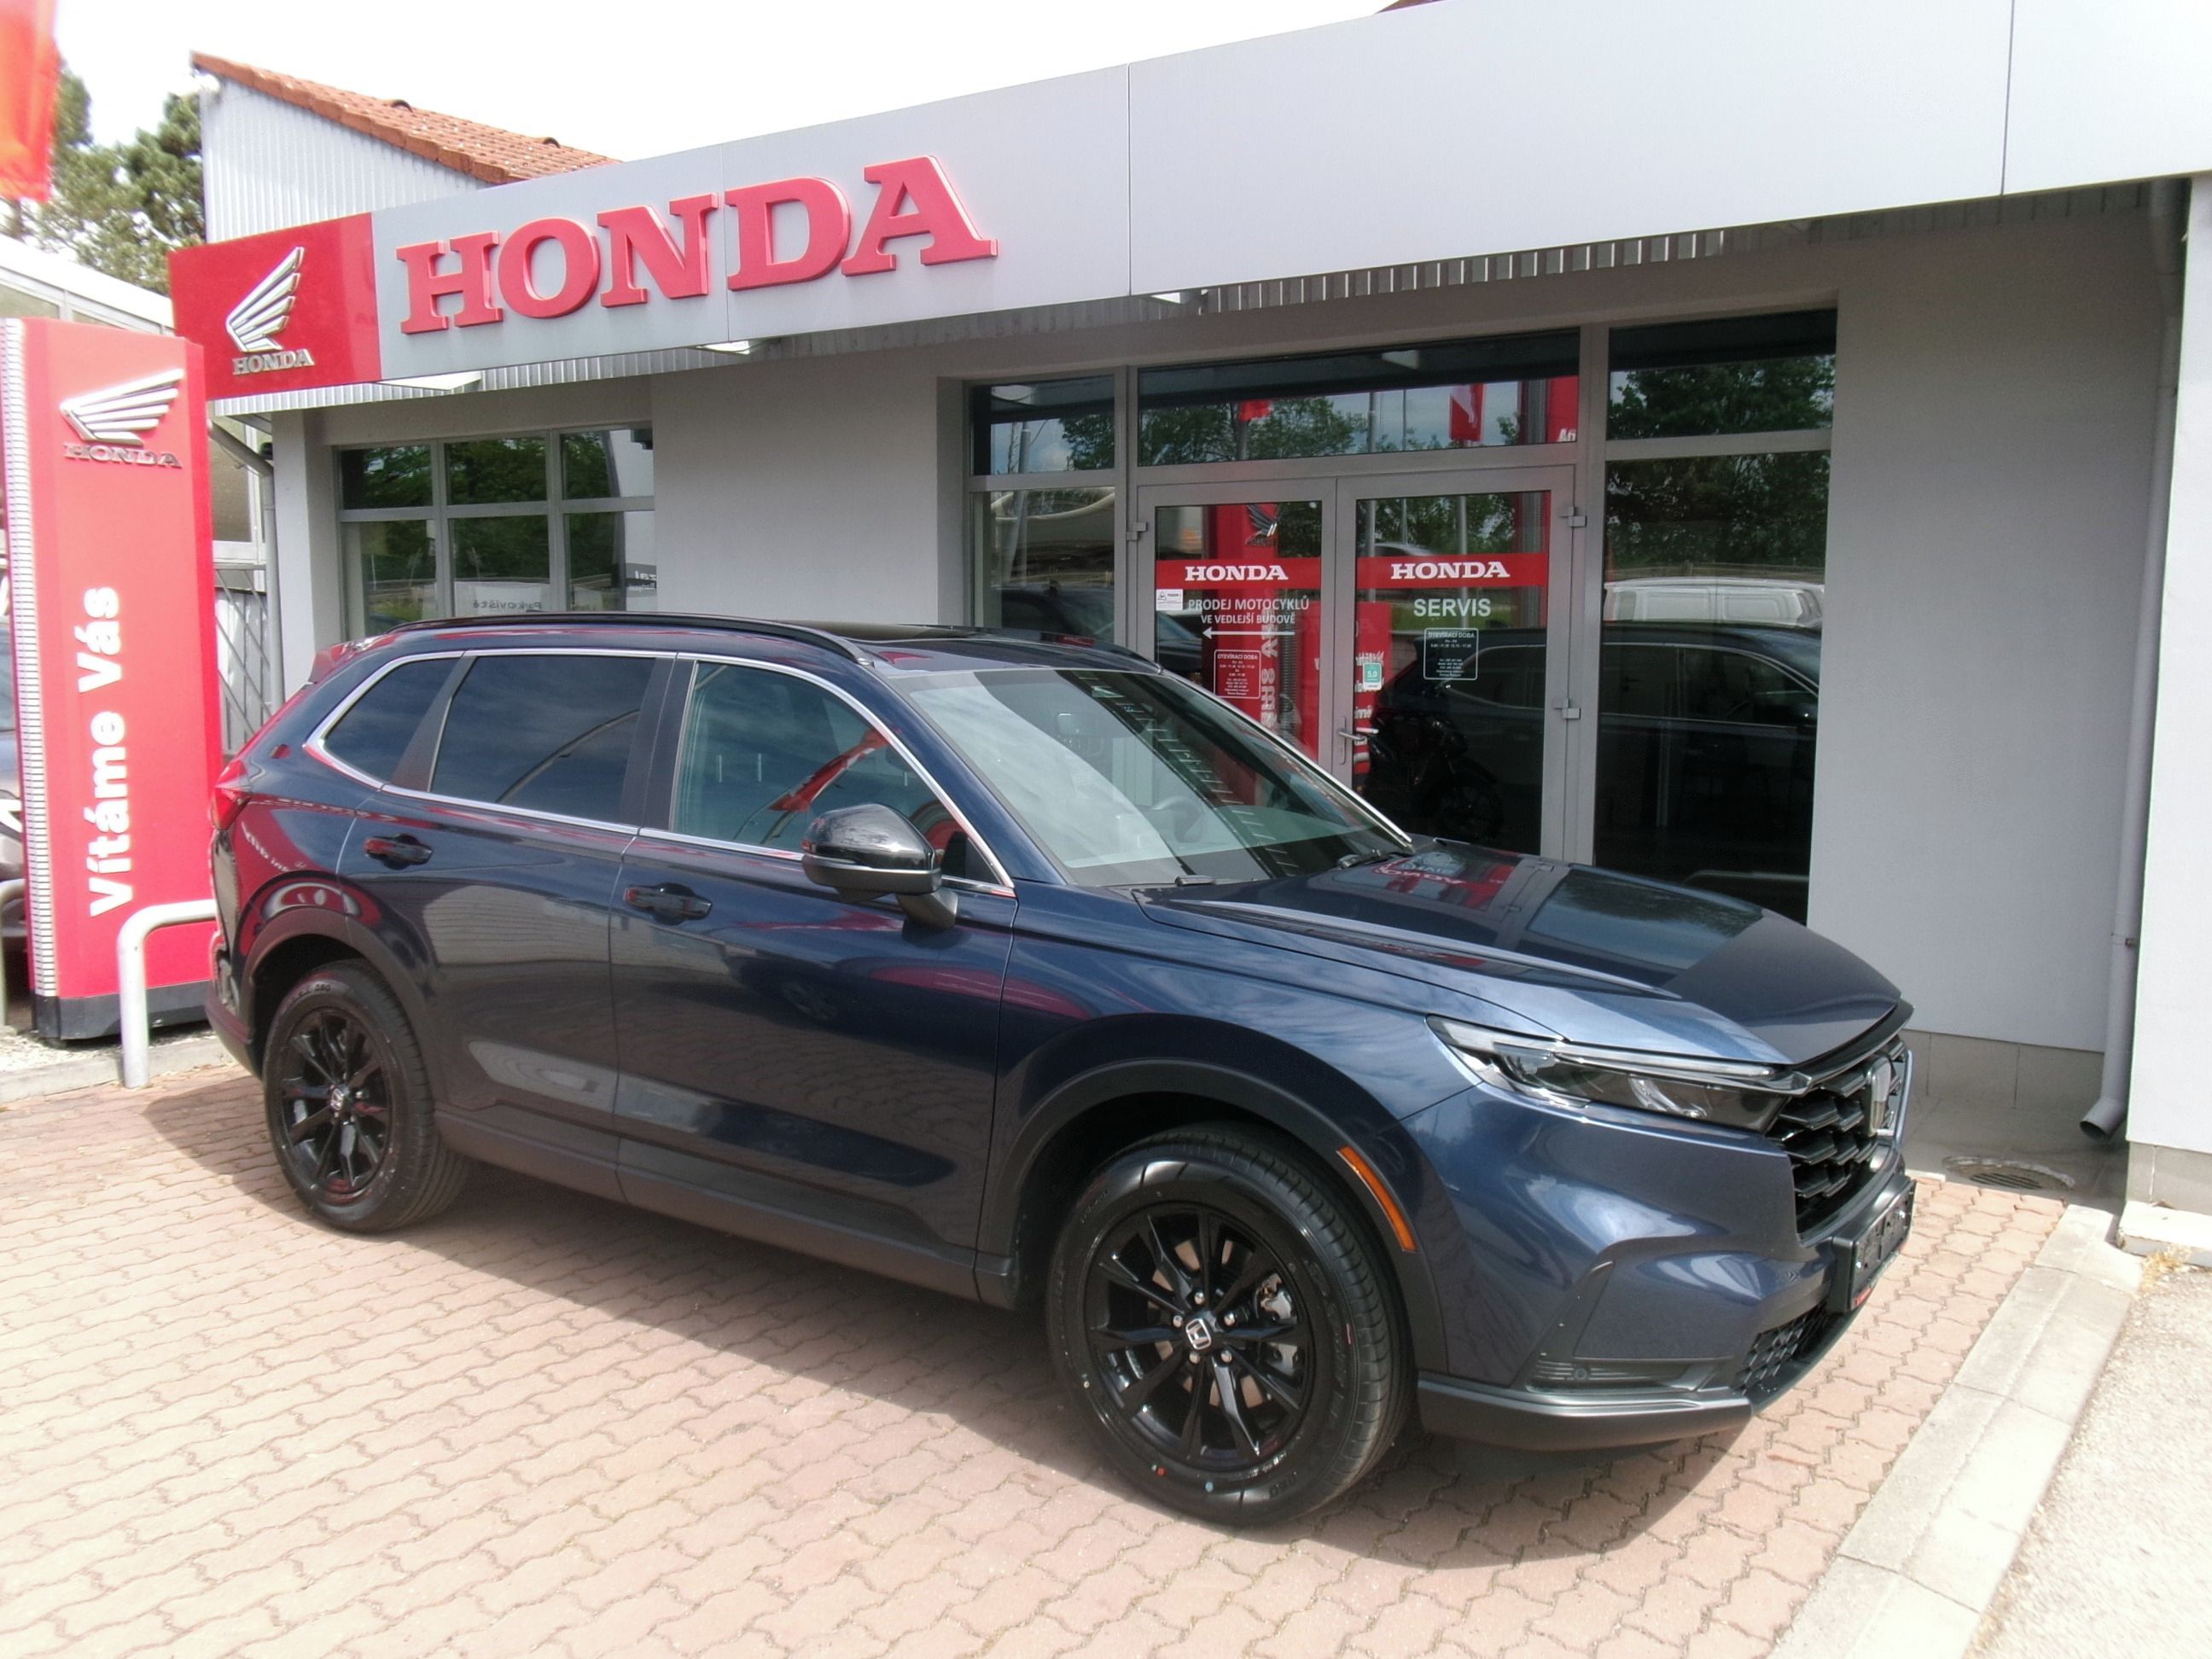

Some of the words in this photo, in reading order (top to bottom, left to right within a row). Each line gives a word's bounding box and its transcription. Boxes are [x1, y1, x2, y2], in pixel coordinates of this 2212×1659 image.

[395, 154, 998, 334] HONDA
[232, 348, 314, 375] HONDA
[63, 443, 182, 469] HONDA
[1185, 565, 1289, 581] HONDA
[1391, 561, 1511, 579] HONDA
[1188, 598, 1231, 611] PRODEJ
[1235, 595, 1309, 611] MOTOCYKLŮ
[1413, 597, 1491, 617] SERVIS
[1201, 614, 1213, 625] VE
[1215, 612, 1254, 625] VEDLEJŠÍ
[74, 586, 122, 693] Vás
[84, 711, 133, 917] Vítáme
